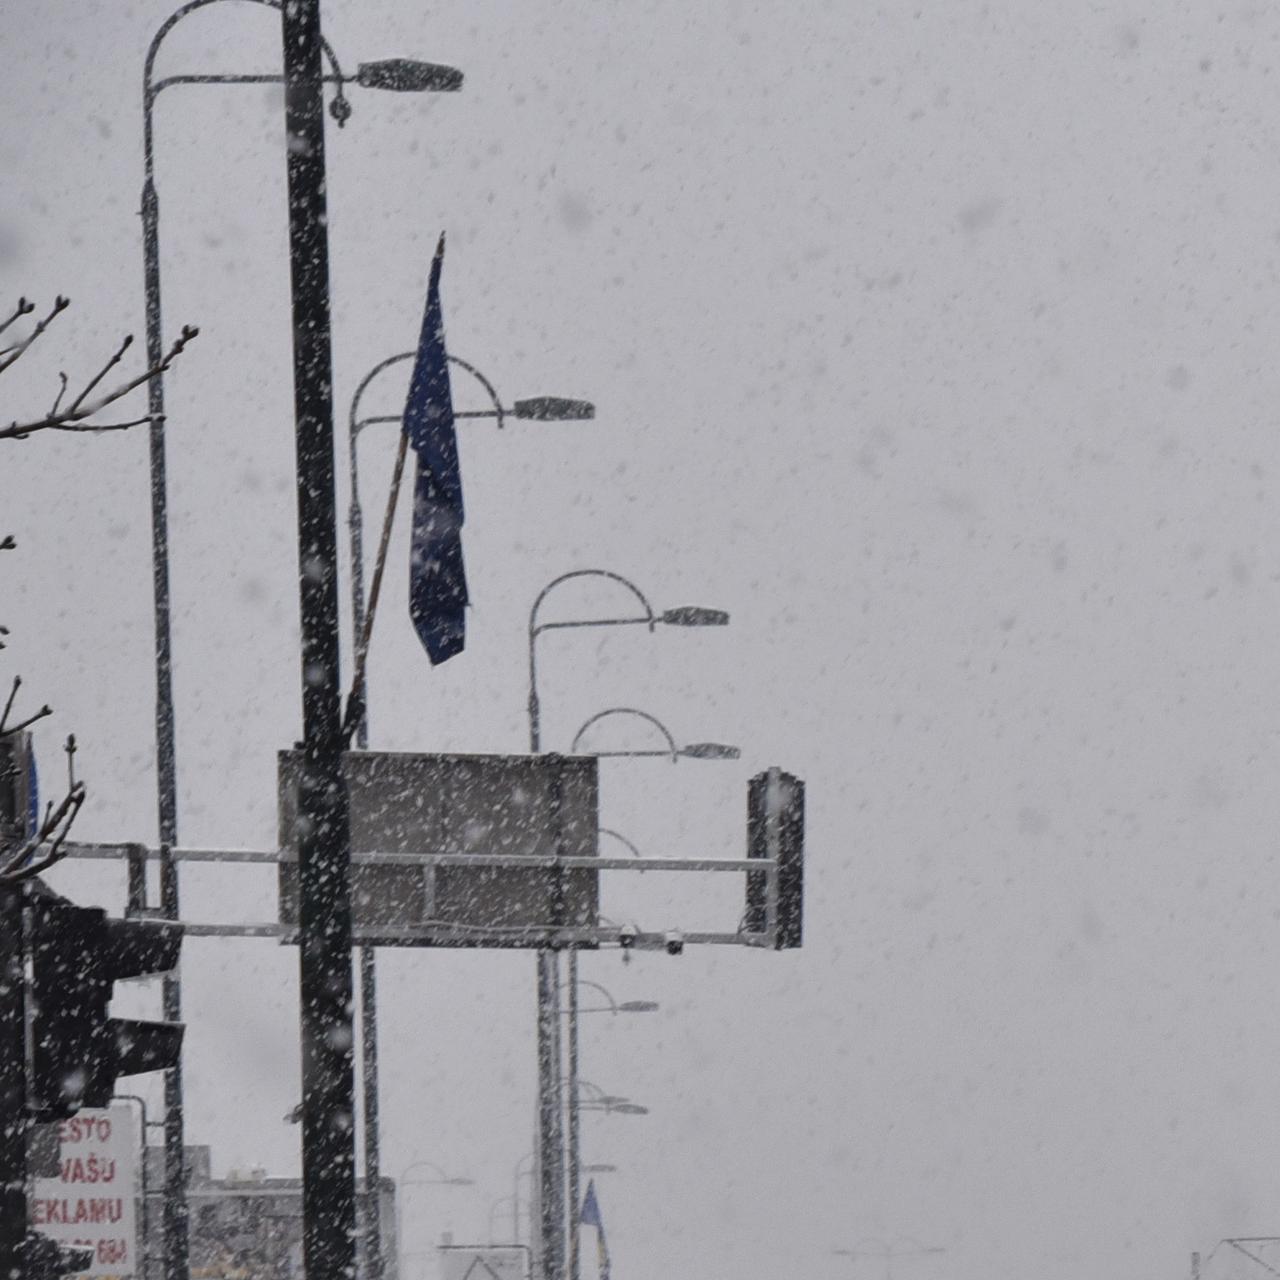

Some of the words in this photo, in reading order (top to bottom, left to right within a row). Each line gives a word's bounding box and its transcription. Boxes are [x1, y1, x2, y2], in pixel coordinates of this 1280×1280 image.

[57, 1117, 112, 1143] ESTO
[60, 1152, 115, 1183] VAŠU
[31, 1198, 122, 1224] EKLAMU
